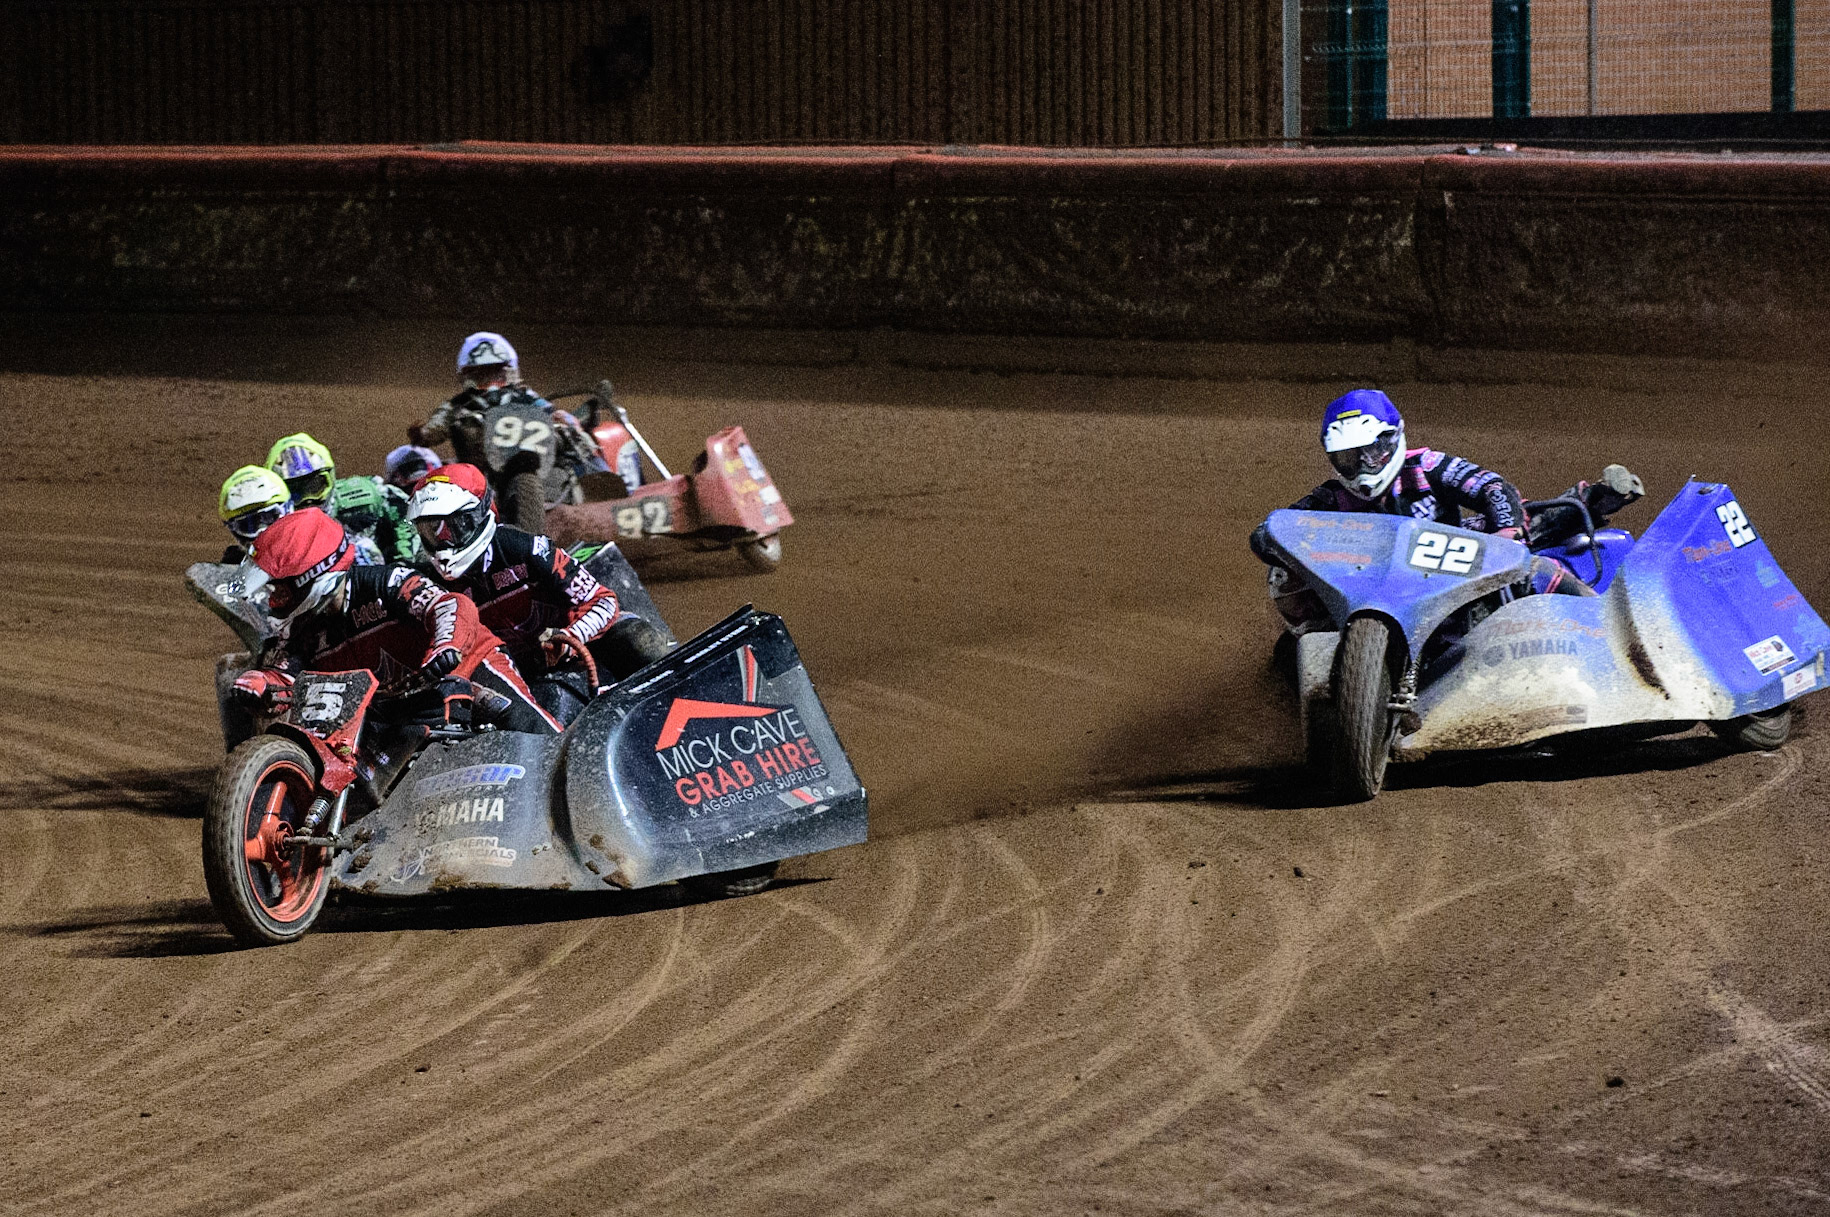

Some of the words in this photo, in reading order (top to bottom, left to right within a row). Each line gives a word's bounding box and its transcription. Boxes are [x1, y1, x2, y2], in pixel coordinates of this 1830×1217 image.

[491, 416, 552, 454] 92
[614, 499, 673, 538] 92
[1715, 500, 1757, 549] 22
[294, 554, 339, 588] WULF
[1409, 531, 1479, 574] 22
[1508, 639, 1578, 660] YAMAHA
[301, 682, 347, 722] 5
[656, 732, 733, 780] MICK
[730, 707, 806, 755] CAVE
[674, 760, 756, 805] GRAB
[754, 737, 822, 780] HIRE
[688, 806, 700, 818] &
[703, 780, 776, 815] AGGREGATE
[774, 763, 828, 790] SUPPLIES
[415, 797, 505, 834] MAHA
